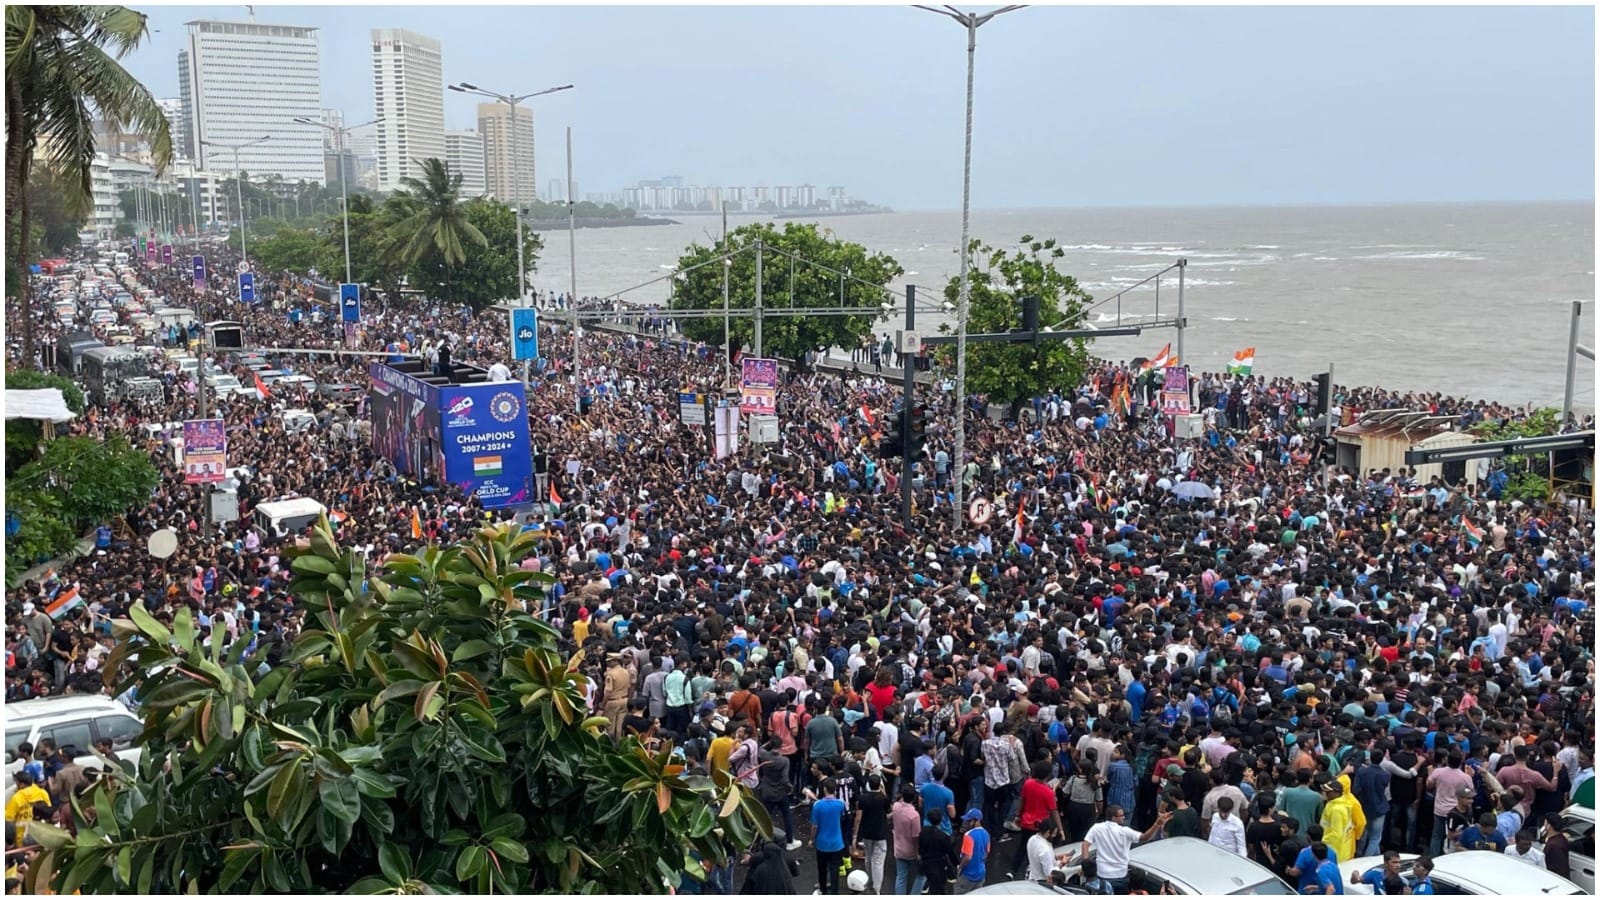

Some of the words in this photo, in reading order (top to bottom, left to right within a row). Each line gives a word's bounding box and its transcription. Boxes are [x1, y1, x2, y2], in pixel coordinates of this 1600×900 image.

[519, 329, 533, 339] Jio
[457, 431, 515, 443] CHAMPIONS
[461, 445, 480, 453] 2007
[487, 442, 506, 451] 2024
[476, 487, 495, 496] ORLD
[496, 486, 509, 494] CUP
